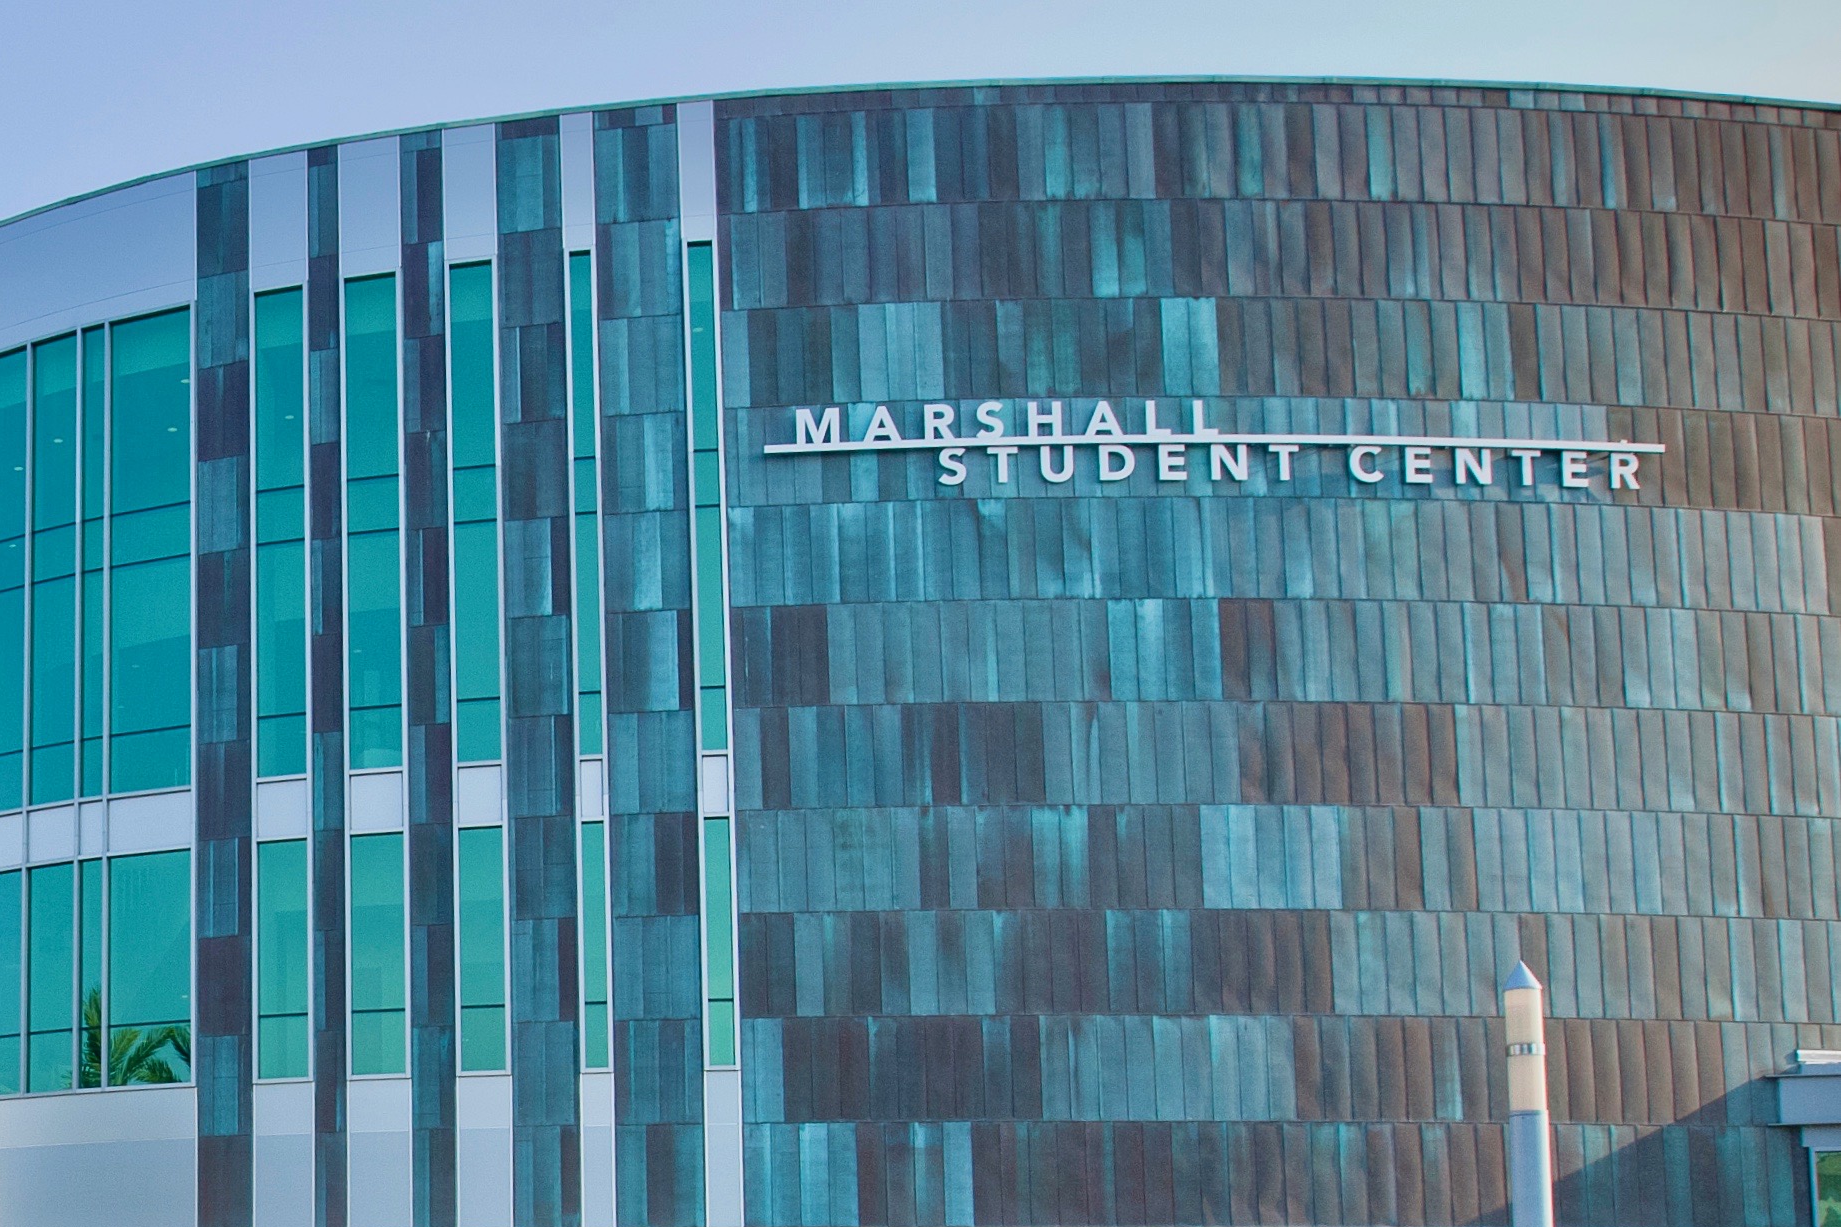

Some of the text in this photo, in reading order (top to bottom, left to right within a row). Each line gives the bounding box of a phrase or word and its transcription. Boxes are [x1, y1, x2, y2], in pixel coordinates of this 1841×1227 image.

[794, 400, 1220, 446] MARSHALL
[938, 444, 1641, 490] STUDENT CENTER
